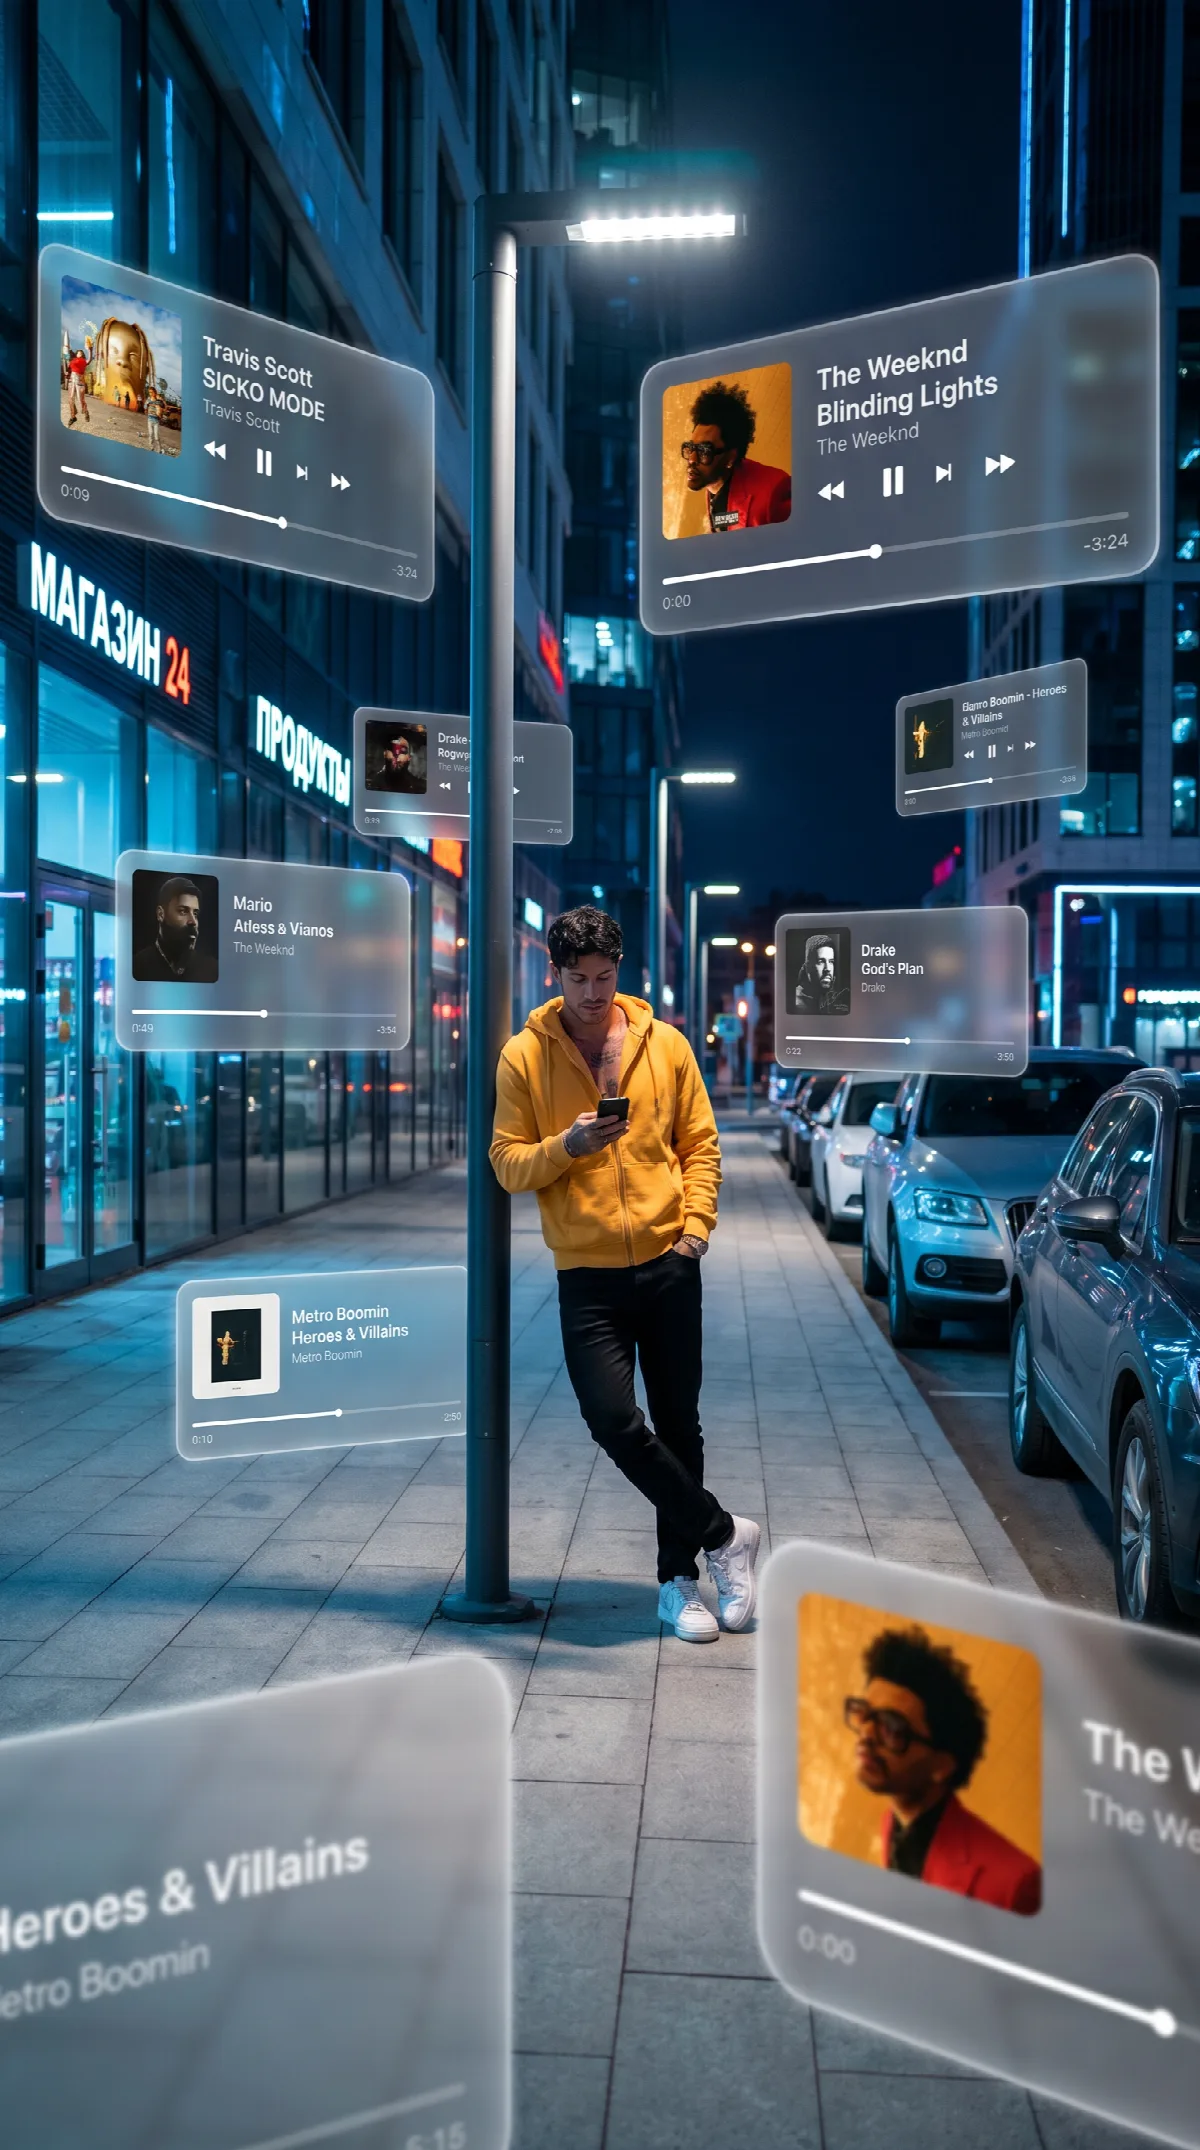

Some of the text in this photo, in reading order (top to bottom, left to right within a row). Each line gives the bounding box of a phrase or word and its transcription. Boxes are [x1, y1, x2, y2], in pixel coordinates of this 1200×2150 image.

[31, 541, 191, 705] МАГАЗИН 24
[256, 694, 351, 807] ПРОДУКТЫ
